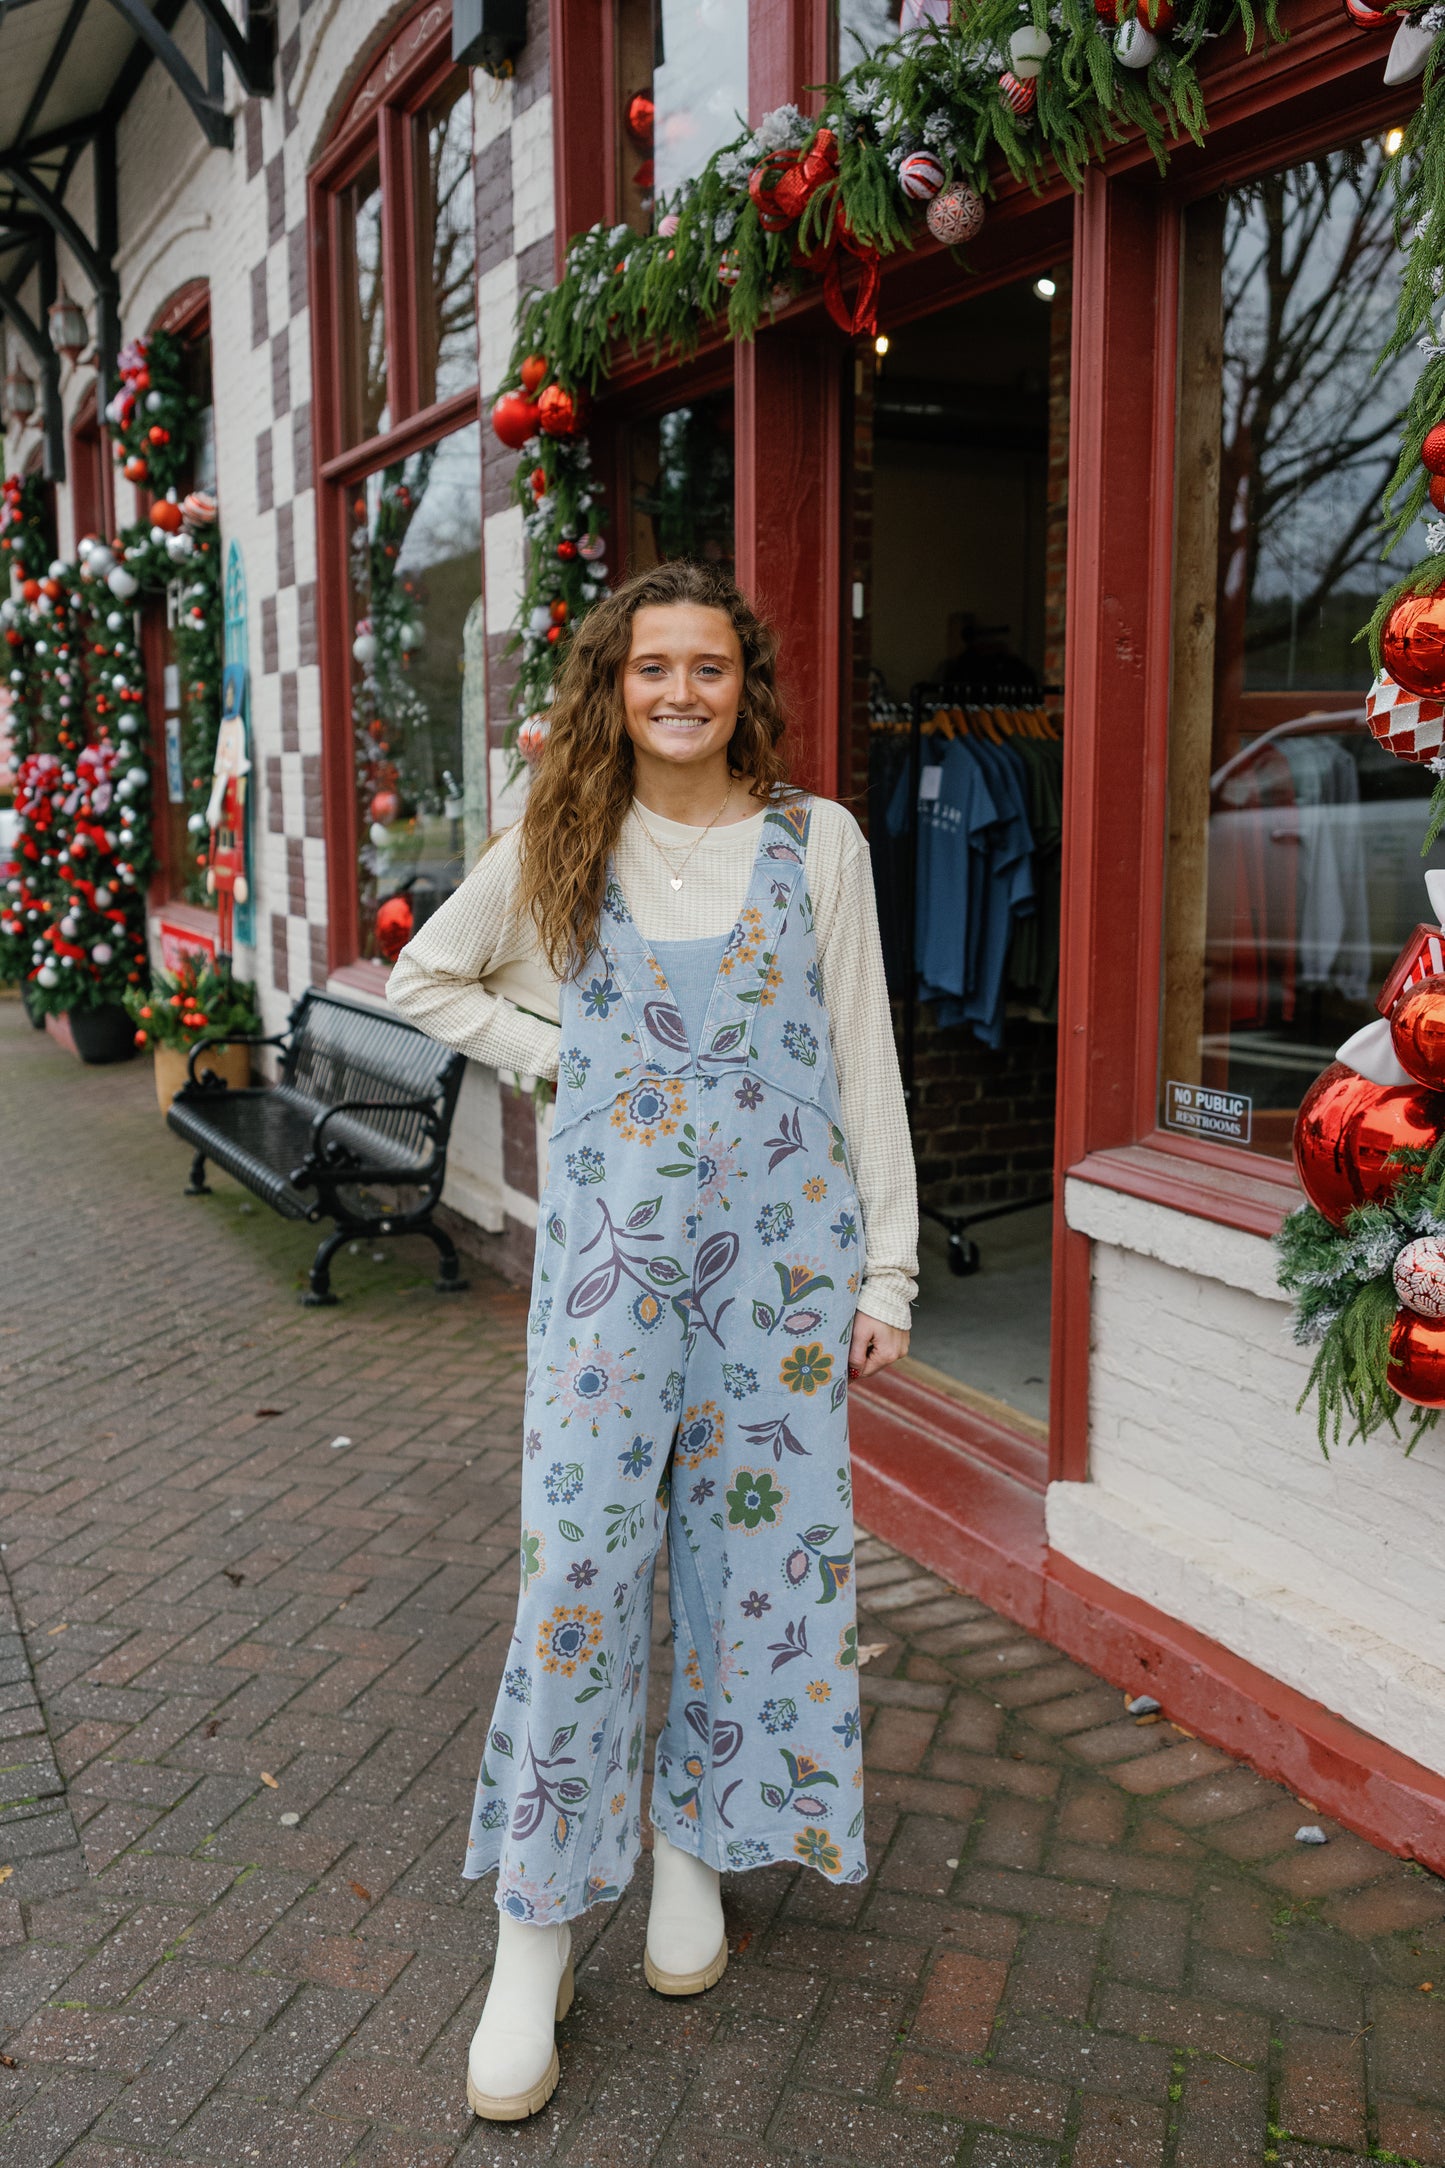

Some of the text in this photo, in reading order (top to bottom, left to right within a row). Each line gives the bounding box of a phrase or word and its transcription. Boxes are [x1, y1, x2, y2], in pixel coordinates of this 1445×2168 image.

[1174, 1087, 1243, 1116] NO PUBLIC
[1175, 1110, 1241, 1135] RESTROOMS
